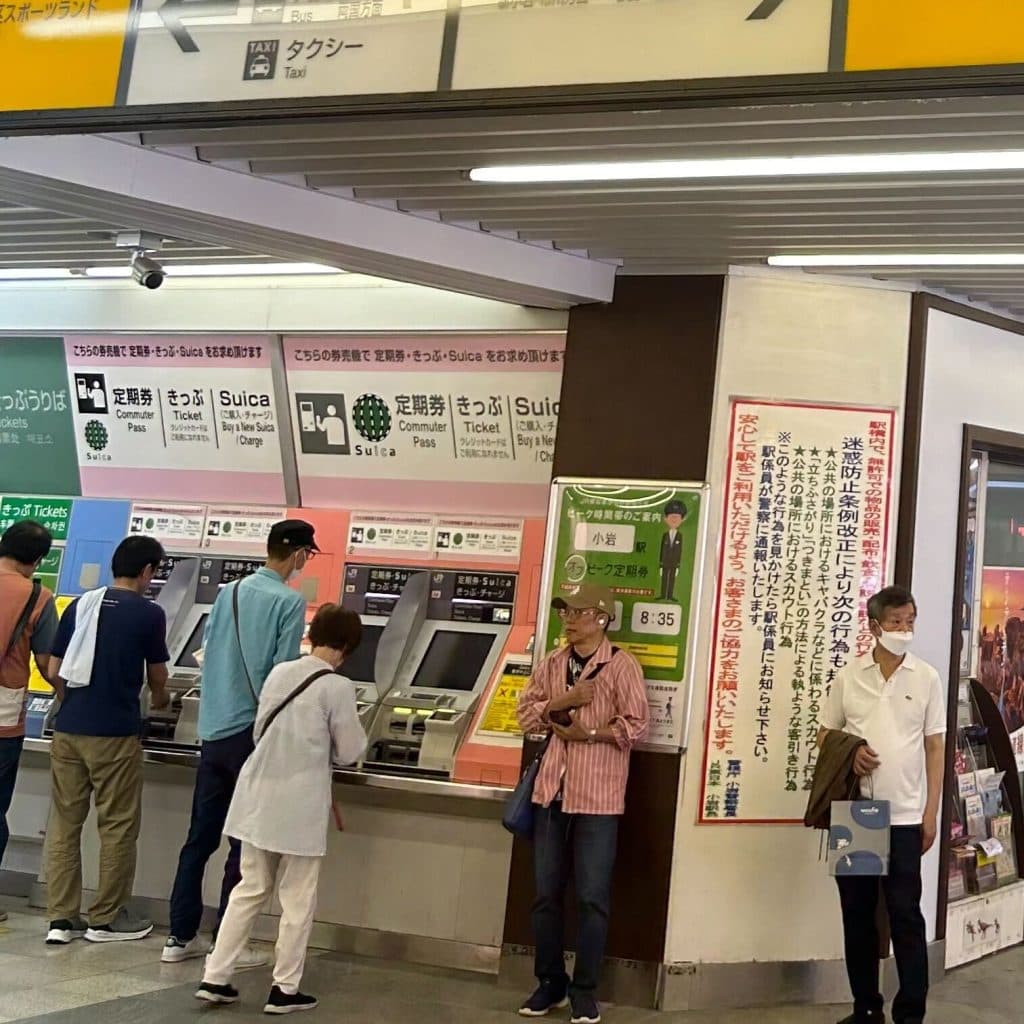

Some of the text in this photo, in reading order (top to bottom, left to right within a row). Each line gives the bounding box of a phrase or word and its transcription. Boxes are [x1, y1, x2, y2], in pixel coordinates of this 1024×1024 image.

[291, 10, 313, 23] Bus
[250, 40, 278, 54] TAXI
[286, 38, 364, 62] タクシー
[284, 65, 307, 79] Taxi
[0, 389, 68, 412] っぷうりば
[112, 387, 153, 407] 定期券
[167, 387, 205, 407] きっぷ
[220, 389, 271, 407] Suica
[394, 393, 446, 416] 定期券
[456, 395, 503, 416] きっぷ
[116, 409, 155, 420] Commuter
[173, 410, 202, 421] Ticket
[0, 416, 28, 429] ckets
[128, 422, 147, 433] Pass
[222, 421, 235, 434] Buy
[256, 422, 275, 432] Suica
[398, 419, 448, 433] Commuter
[463, 421, 500, 434] Ticket
[239, 435, 263, 448] Charge
[413, 436, 436, 448] Pass
[517, 434, 533, 448] Buy
[541, 435, 557, 446] Ne
[86, 452, 112, 461] Suica
[354, 445, 397, 457] Suica
[2, 503, 68, 518] きっぷ Tickets
[592, 531, 617, 547] 小岩
[635, 541, 647, 553] 駅
[639, 609, 675, 627] 8:35
